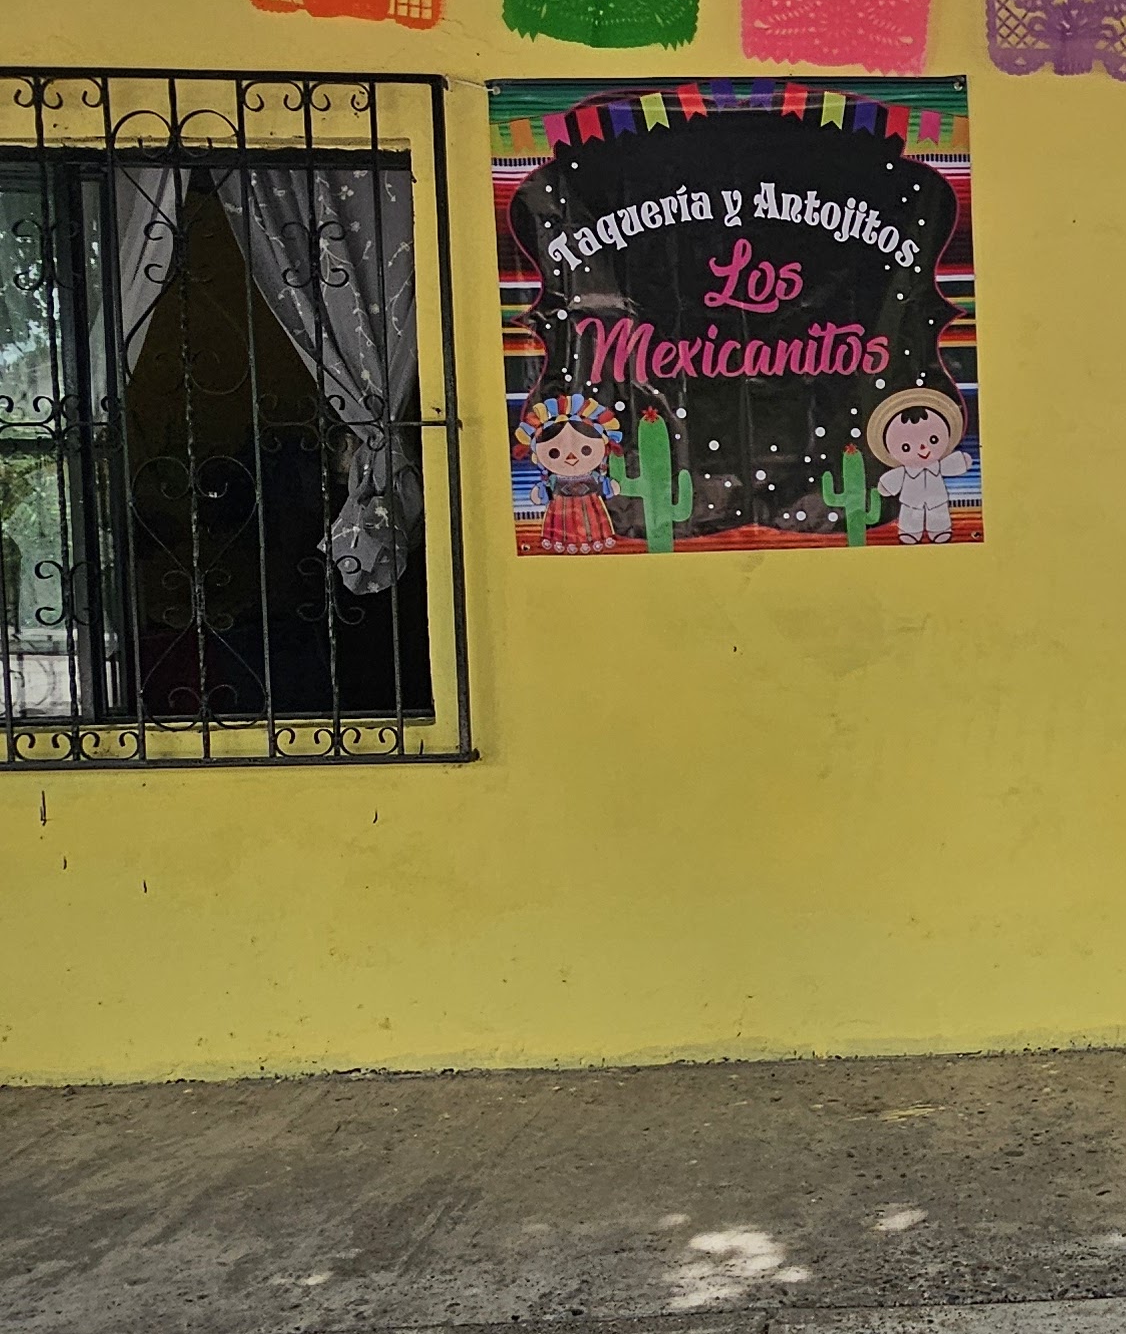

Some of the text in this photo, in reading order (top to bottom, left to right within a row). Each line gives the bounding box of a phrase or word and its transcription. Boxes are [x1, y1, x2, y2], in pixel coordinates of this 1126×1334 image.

[548, 182, 920, 270] Taquería y Antojitos
[705, 238, 803, 312] Los
[575, 318, 890, 384] Mexicanitos
